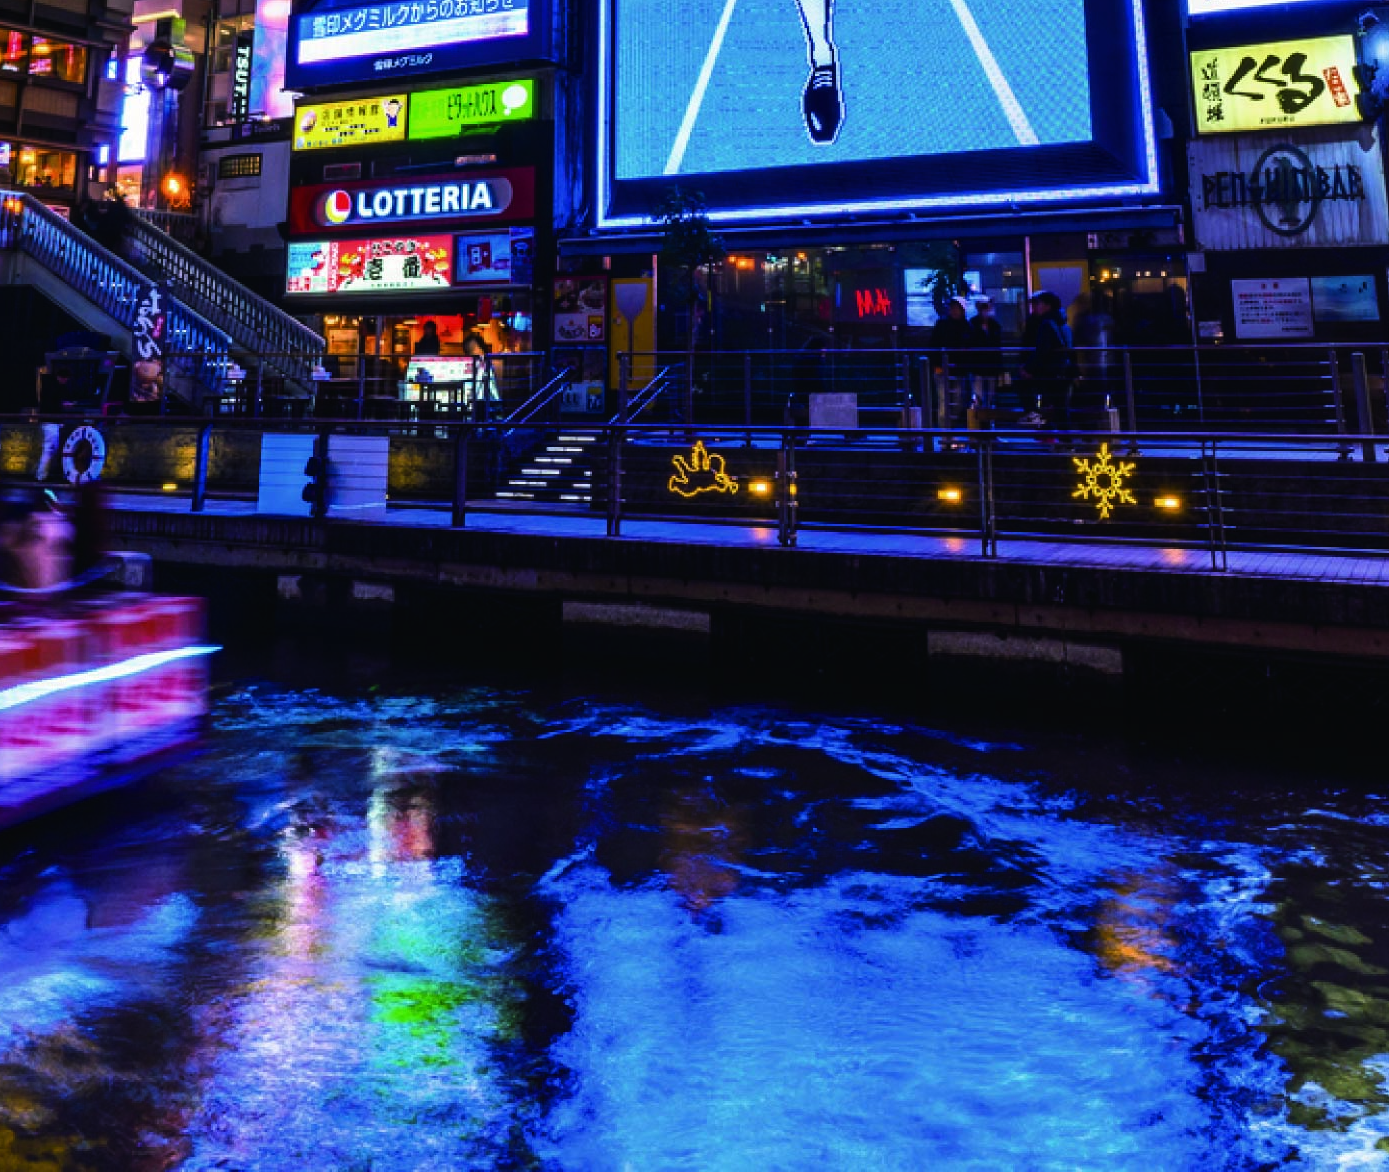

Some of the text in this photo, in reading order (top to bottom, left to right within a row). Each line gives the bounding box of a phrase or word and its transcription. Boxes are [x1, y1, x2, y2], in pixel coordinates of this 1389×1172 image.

[1223, 52, 1326, 115] くくる
[357, 182, 493, 217] LOTTERIA
